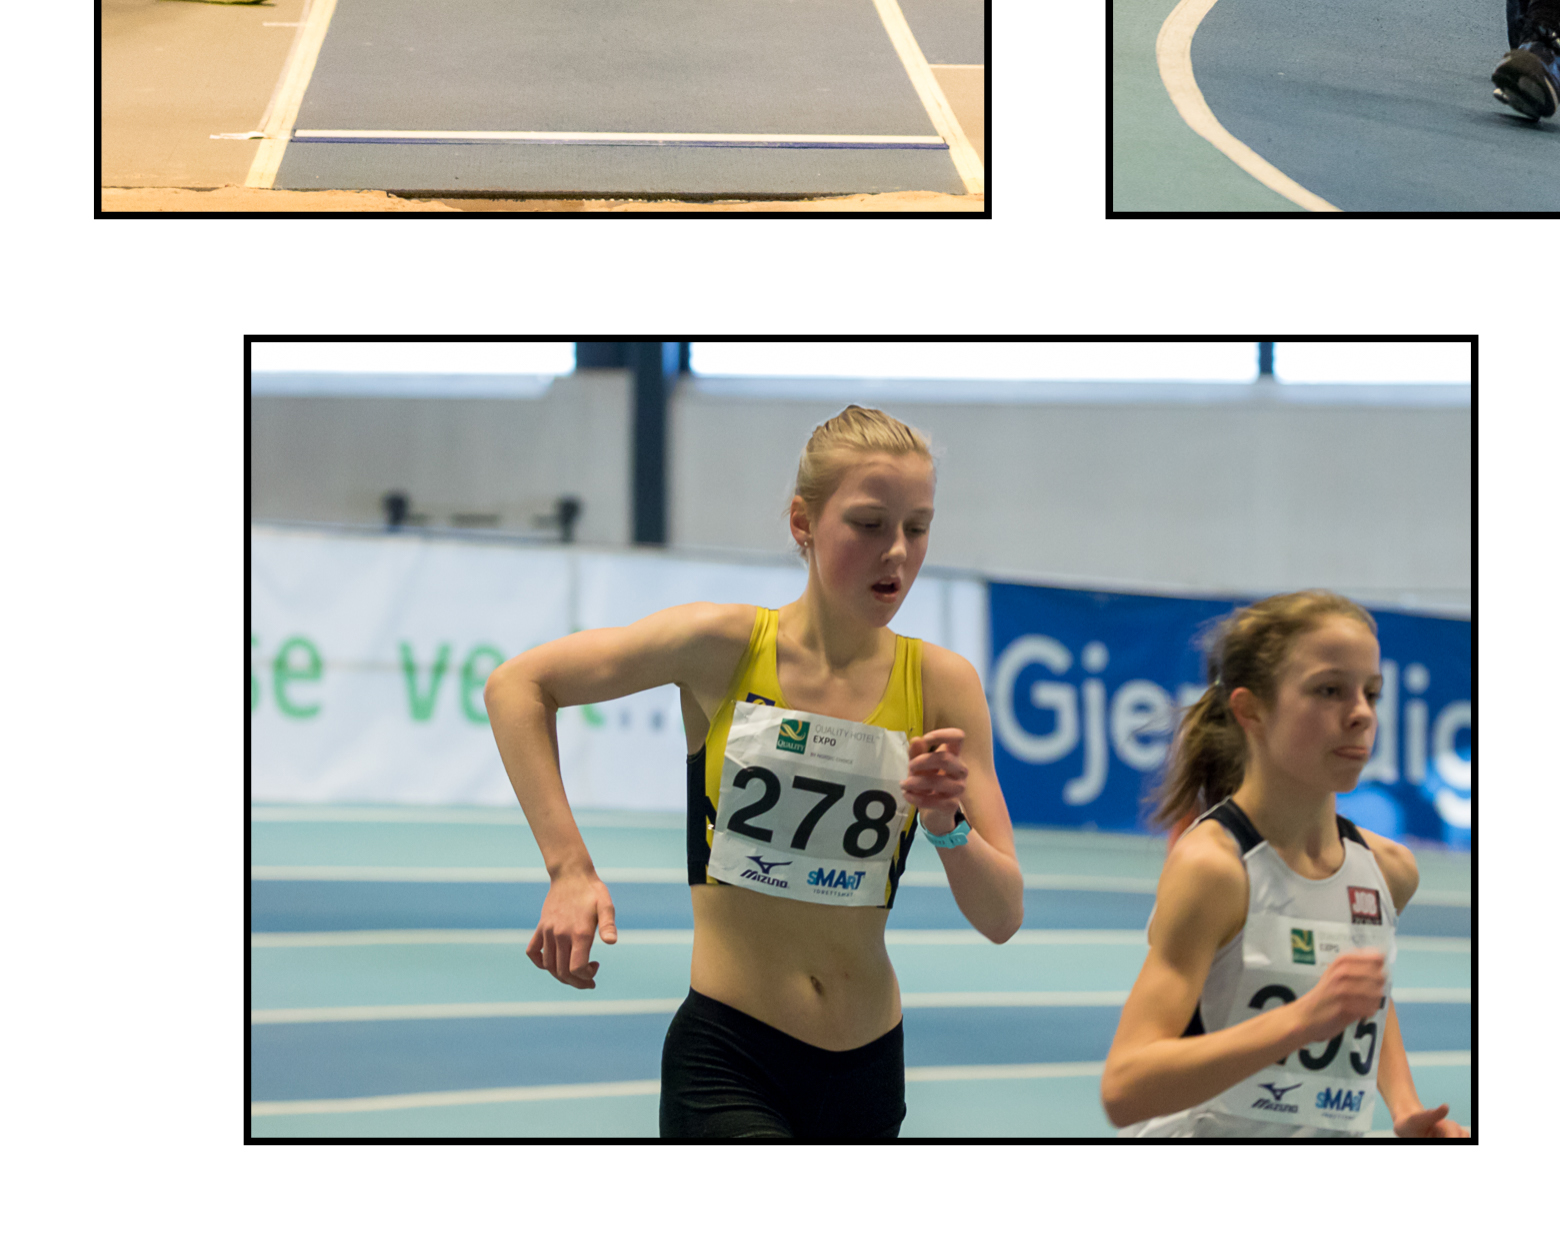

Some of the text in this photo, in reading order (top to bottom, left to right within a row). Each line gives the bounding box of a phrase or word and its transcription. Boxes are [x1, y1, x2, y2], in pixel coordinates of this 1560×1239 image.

[815, 724, 850, 739] QUALITY
[777, 738, 806, 752] QUALITY
[813, 735, 837, 747] EXPO
[727, 766, 898, 858] 278
[807, 868, 866, 890] SMART
